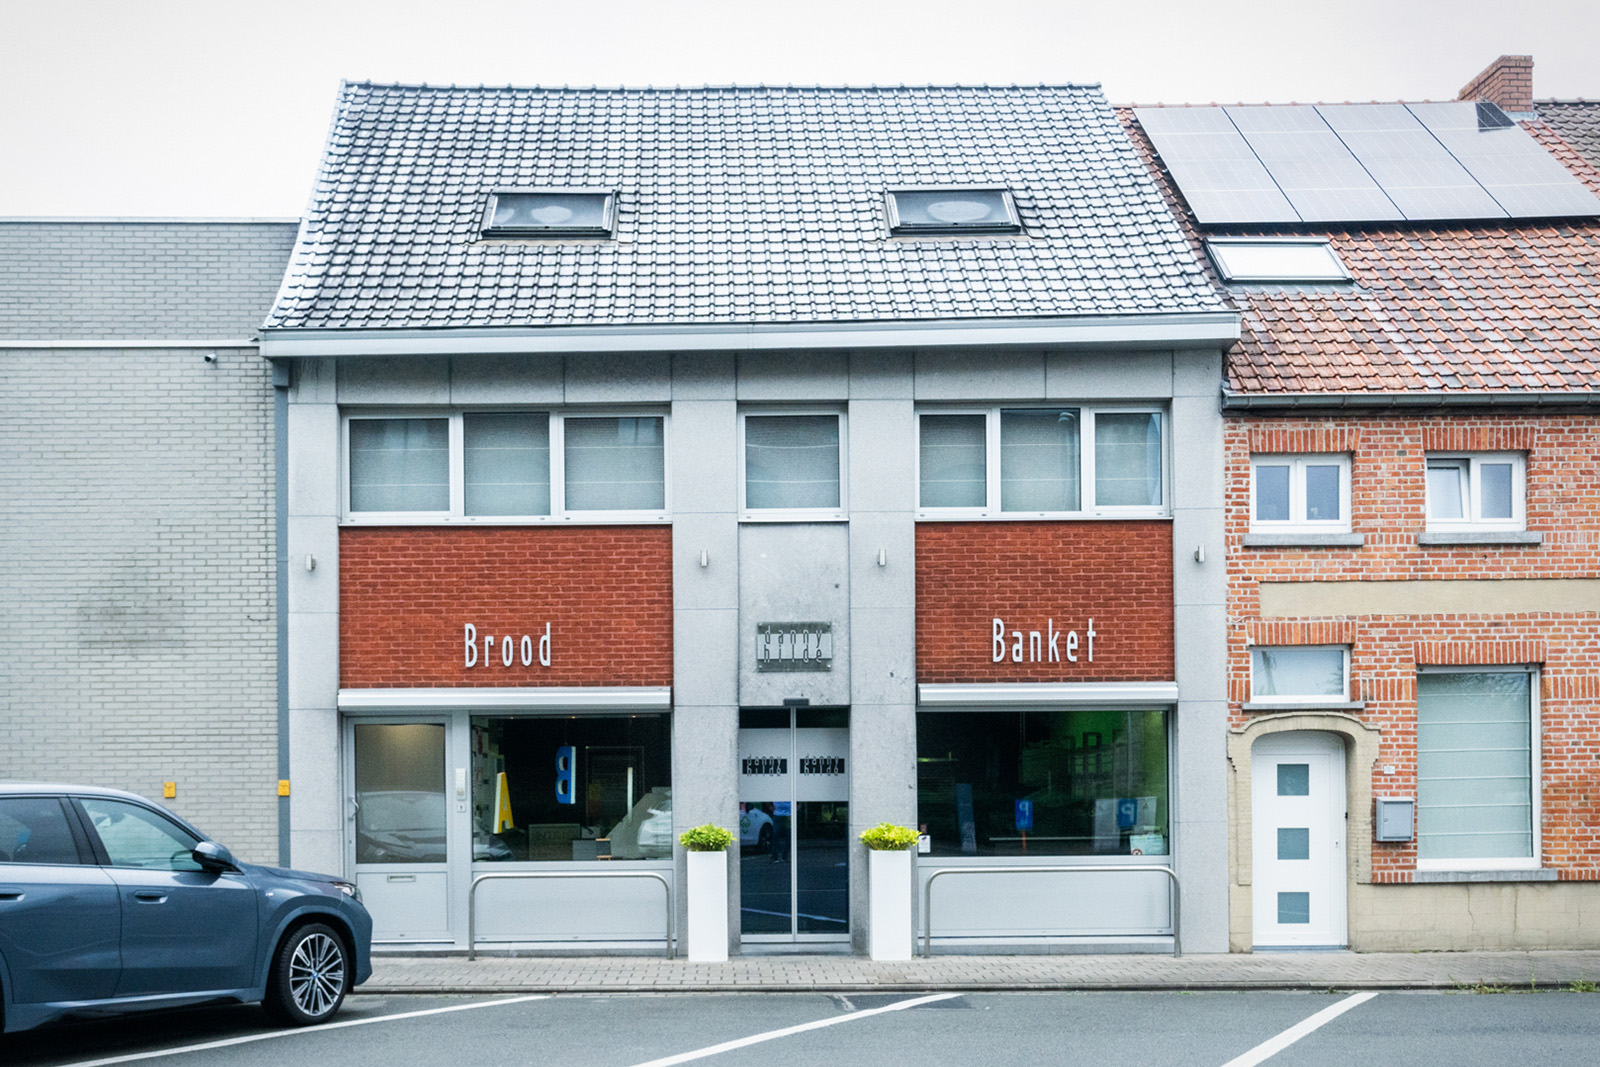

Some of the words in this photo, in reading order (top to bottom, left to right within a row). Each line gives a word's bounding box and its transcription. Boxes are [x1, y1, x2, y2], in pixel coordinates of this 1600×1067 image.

[464, 621, 552, 668] Brood
[764, 625, 822, 648] danny
[992, 617, 1097, 663] Banket
[763, 644, 822, 663] hilde
[747, 754, 782, 767] danny
[804, 753, 839, 767] danny
